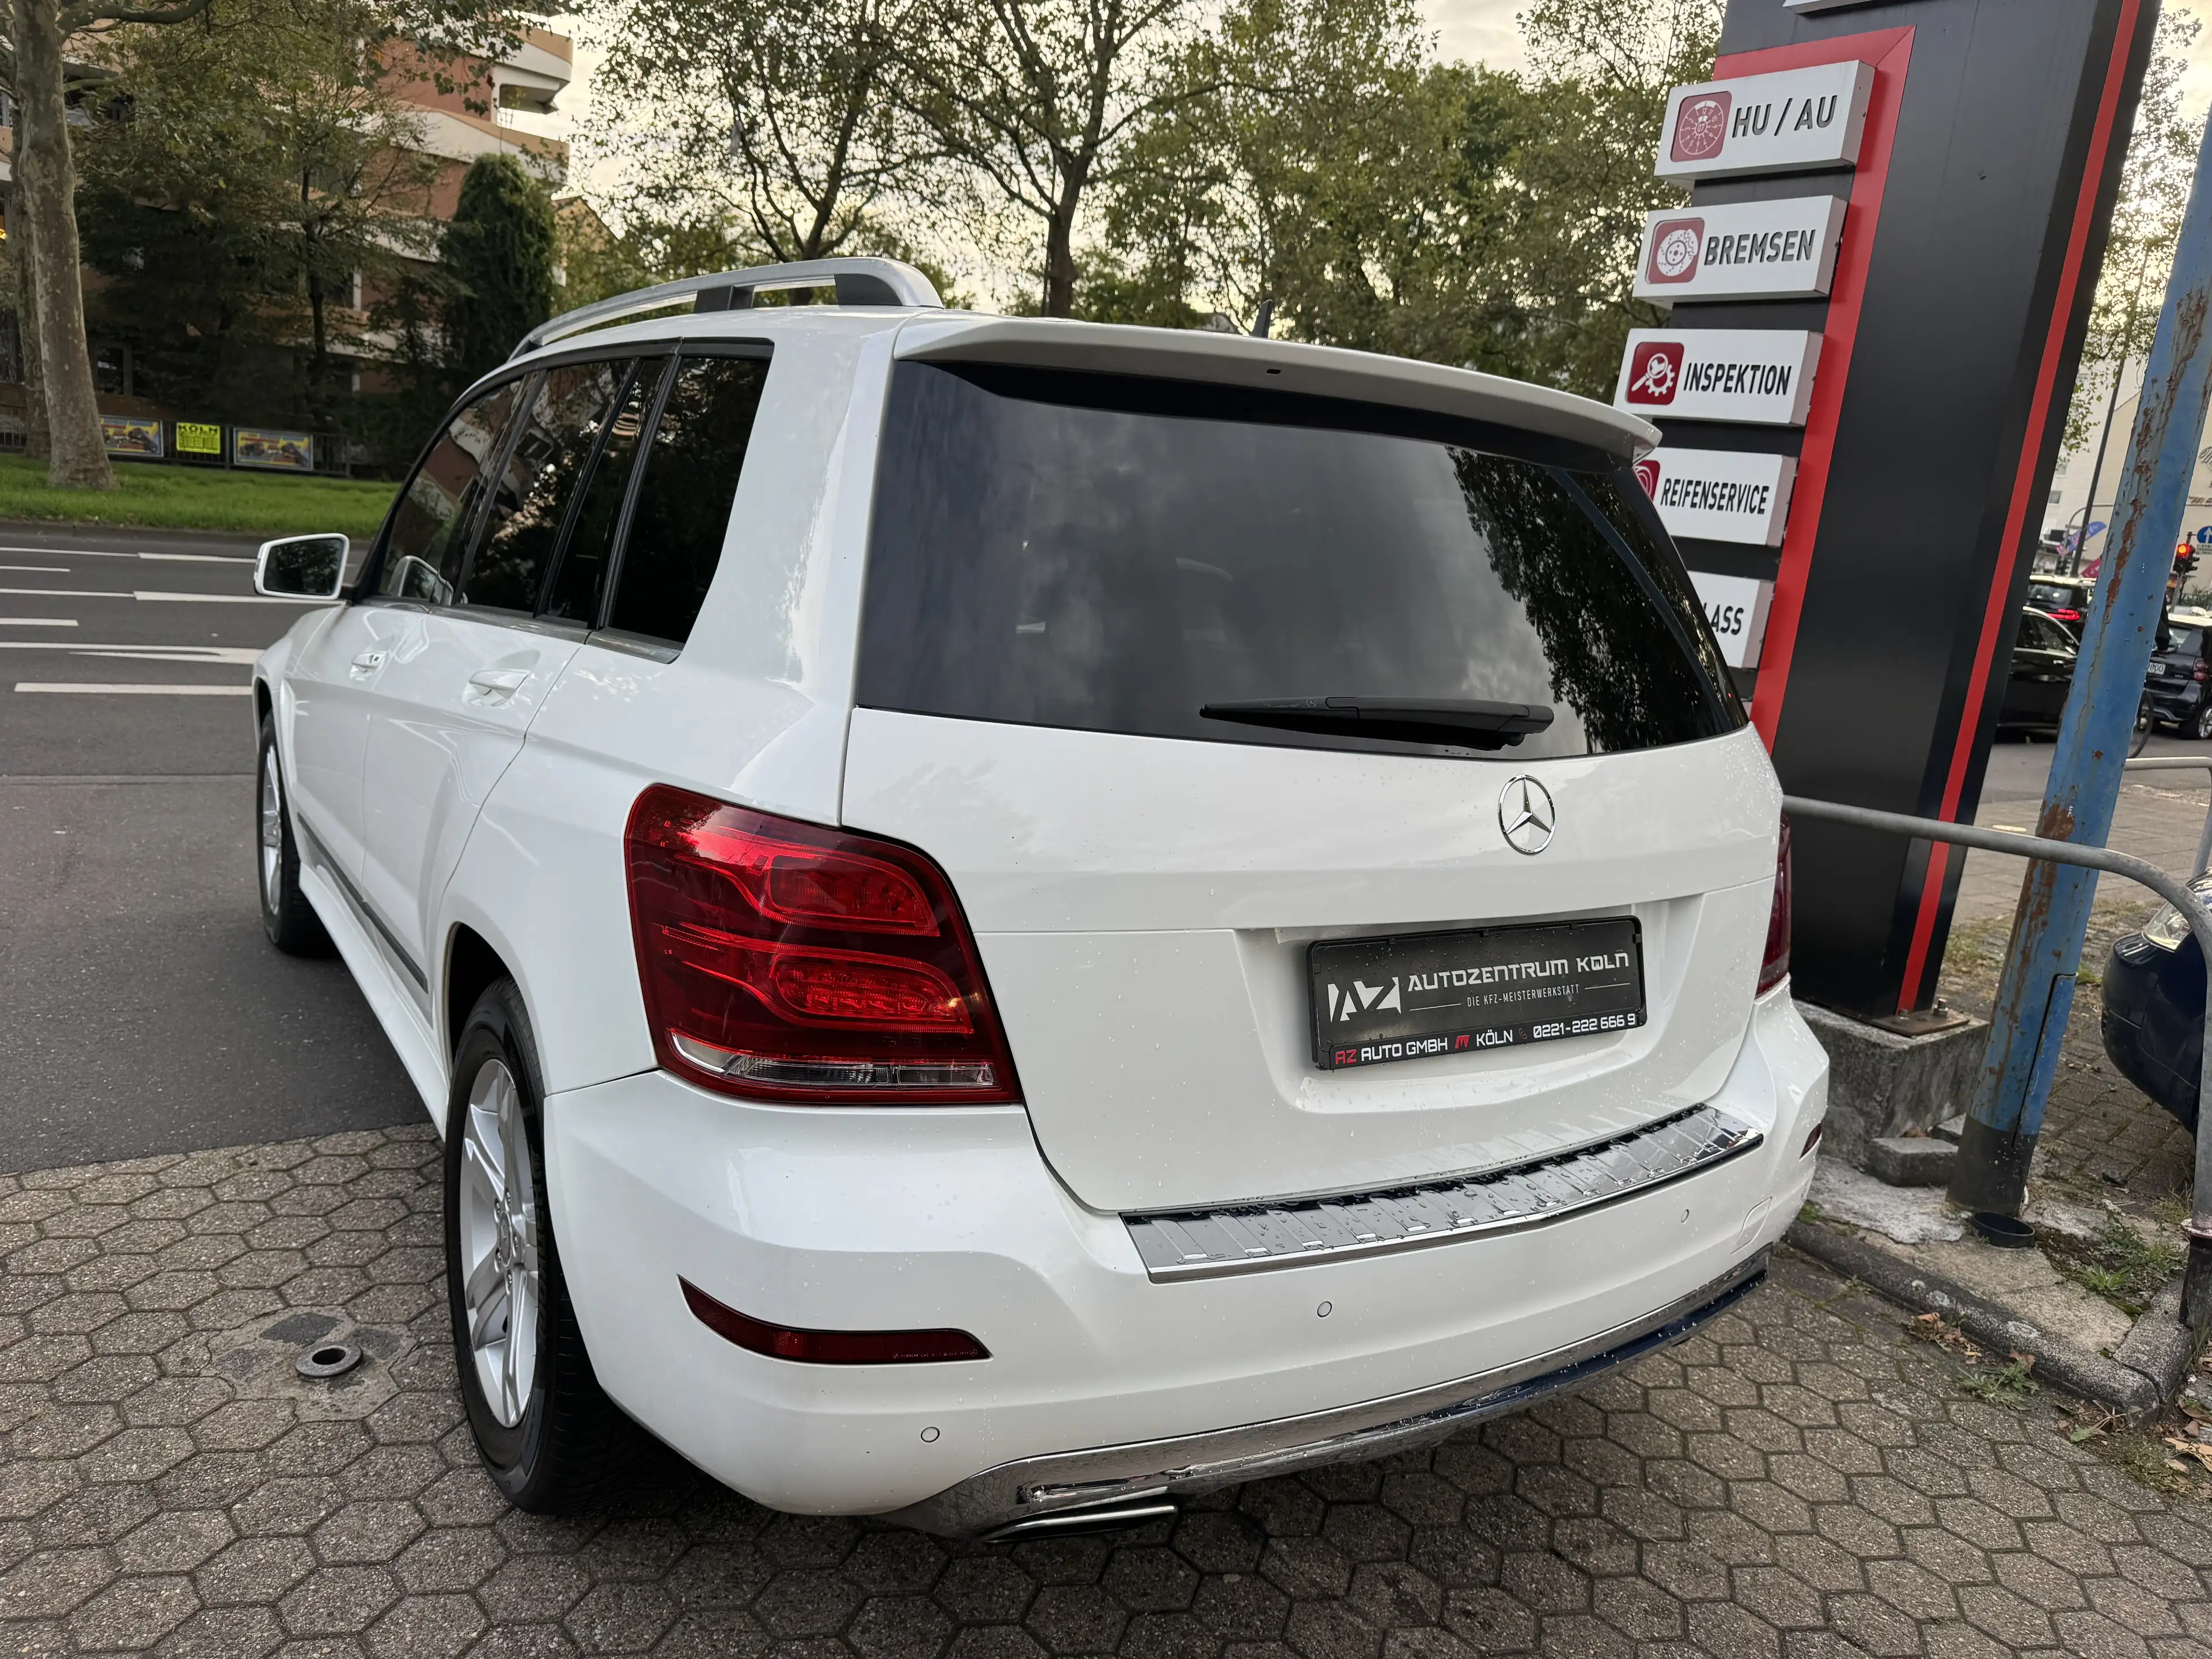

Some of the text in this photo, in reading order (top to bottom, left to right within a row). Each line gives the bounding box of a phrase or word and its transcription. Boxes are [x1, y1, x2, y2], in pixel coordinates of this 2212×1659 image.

[1703, 229, 1816, 266] BREMSEN
[1683, 362, 1792, 396] INSPEKTION
[1660, 478, 1770, 515] REIFENSERVICE
[1408, 959, 1569, 992] AUTOZENTRUM
[1467, 984, 1580, 1007] DIE KFZ-MEISTERWERKSTATT
[1335, 1049, 1357, 1066] AZ
[1361, 1043, 1403, 1062] AUTO
[1406, 1037, 1449, 1056] GMBH
[1476, 1029, 1513, 1047] KÖLN
